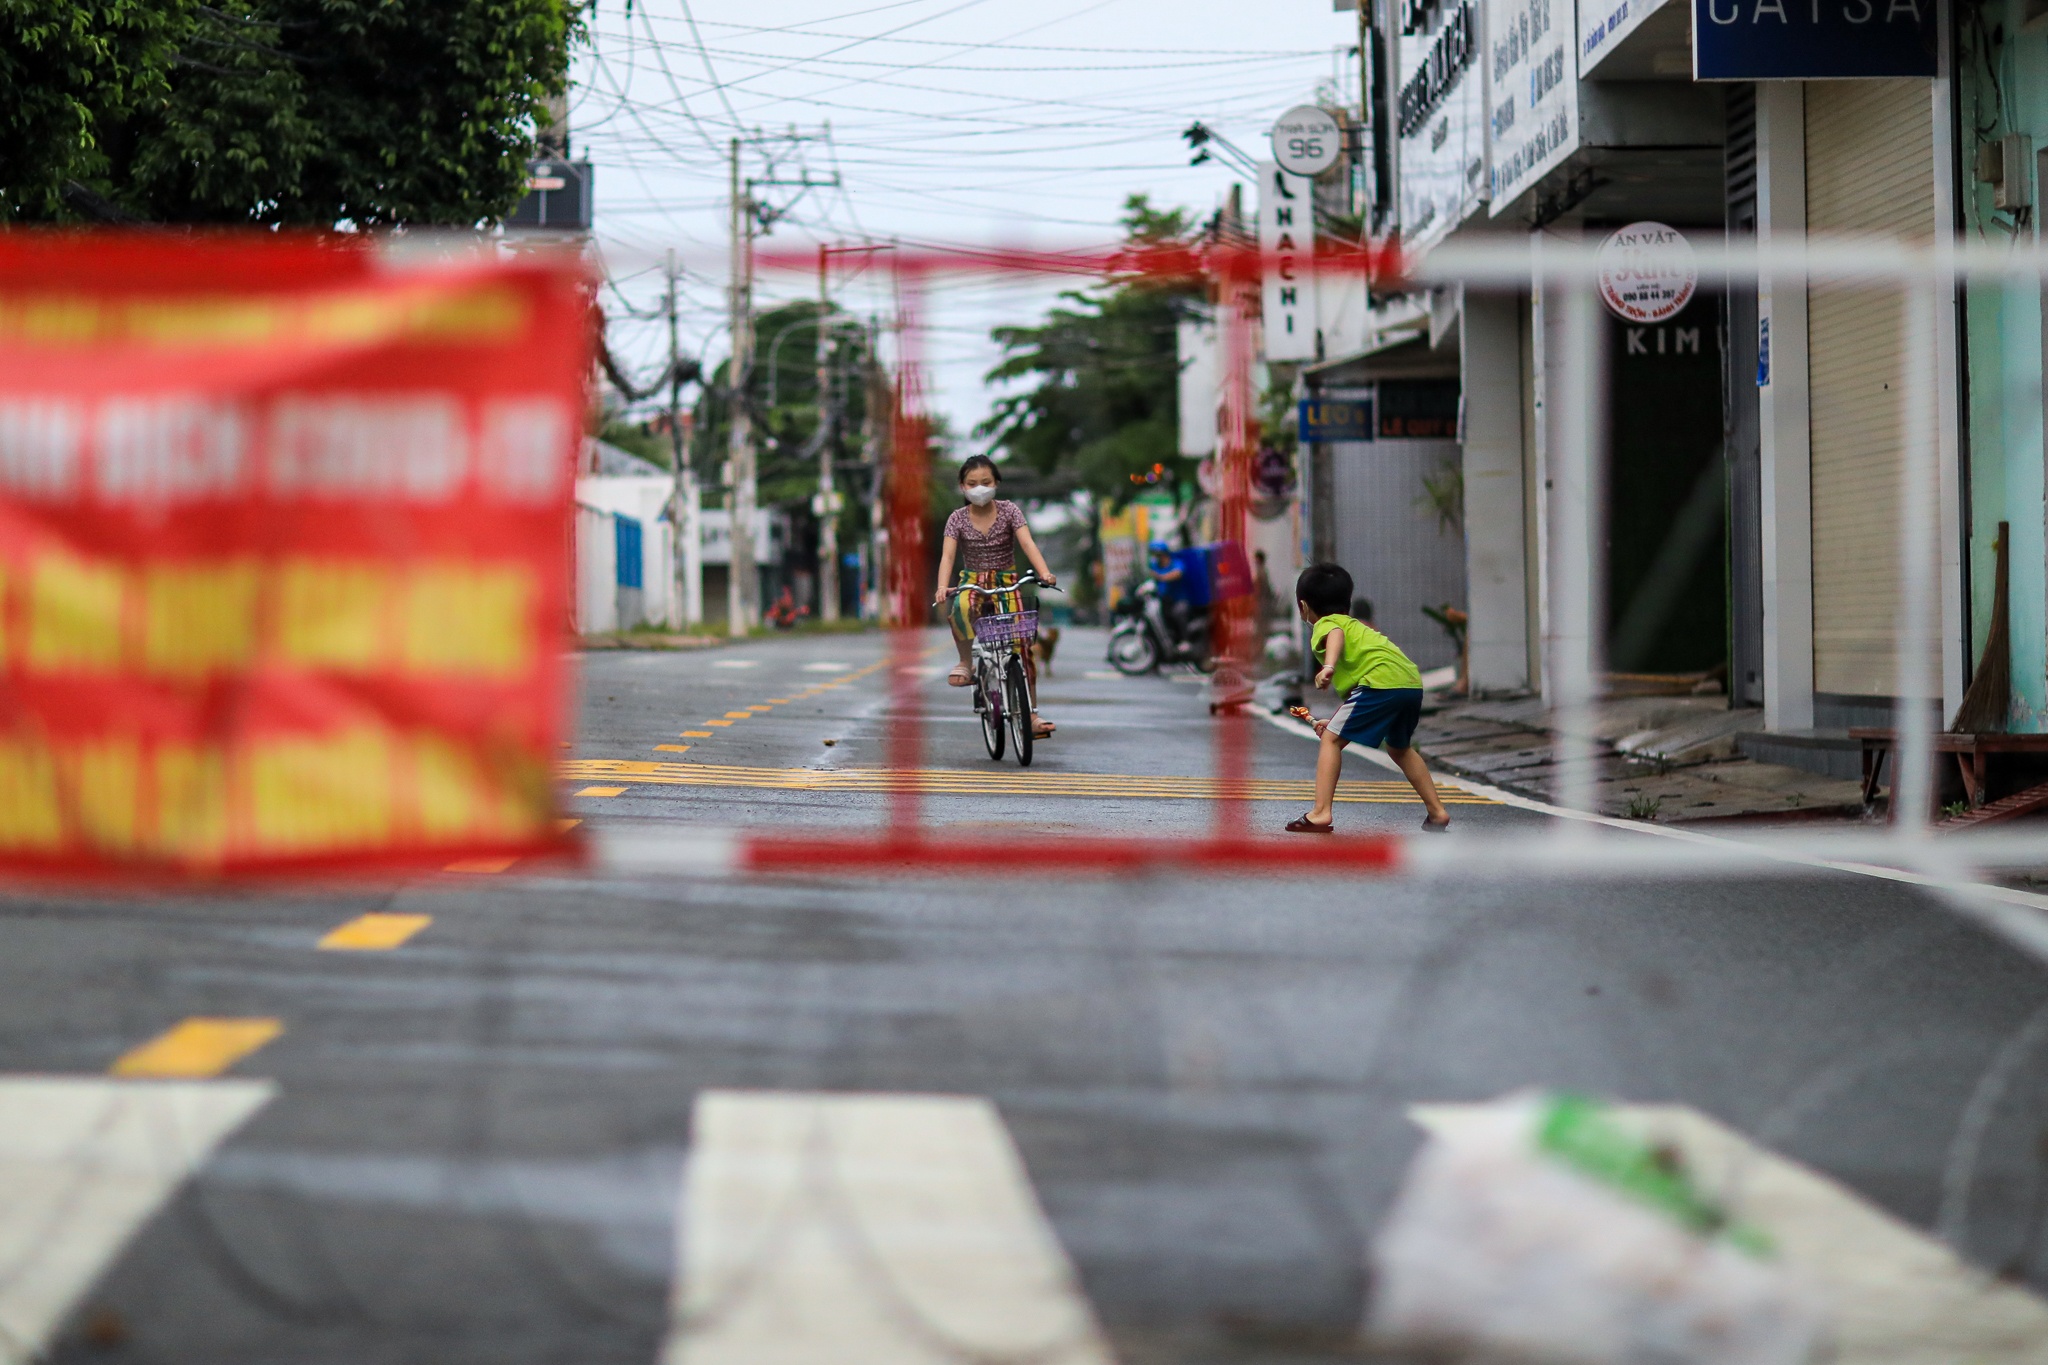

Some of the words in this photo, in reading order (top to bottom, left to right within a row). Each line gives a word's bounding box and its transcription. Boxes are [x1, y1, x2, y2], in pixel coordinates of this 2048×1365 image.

[1288, 138, 1324, 159] 96
[1641, 229, 1677, 247] VẬT
[1277, 206, 1298, 334] HACHI
[1627, 326, 1699, 355] KIM
